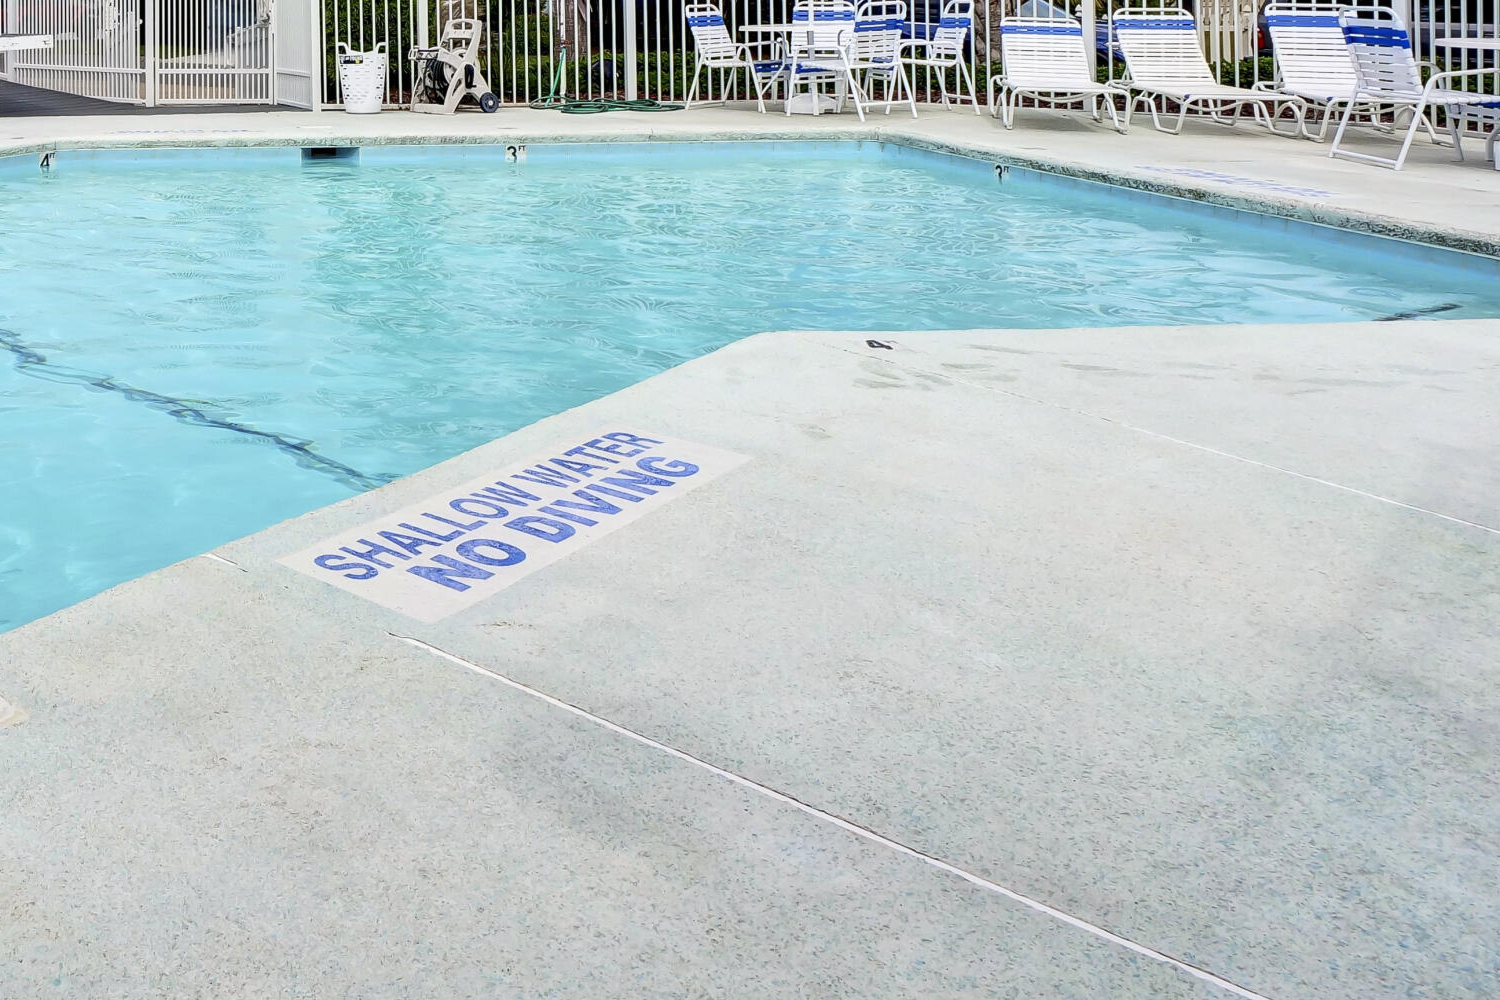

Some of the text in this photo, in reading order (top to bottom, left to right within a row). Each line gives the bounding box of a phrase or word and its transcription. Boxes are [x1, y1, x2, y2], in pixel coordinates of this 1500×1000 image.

[314, 431, 666, 580] SHALLOW WATER
[406, 456, 700, 593] NO DIVING
